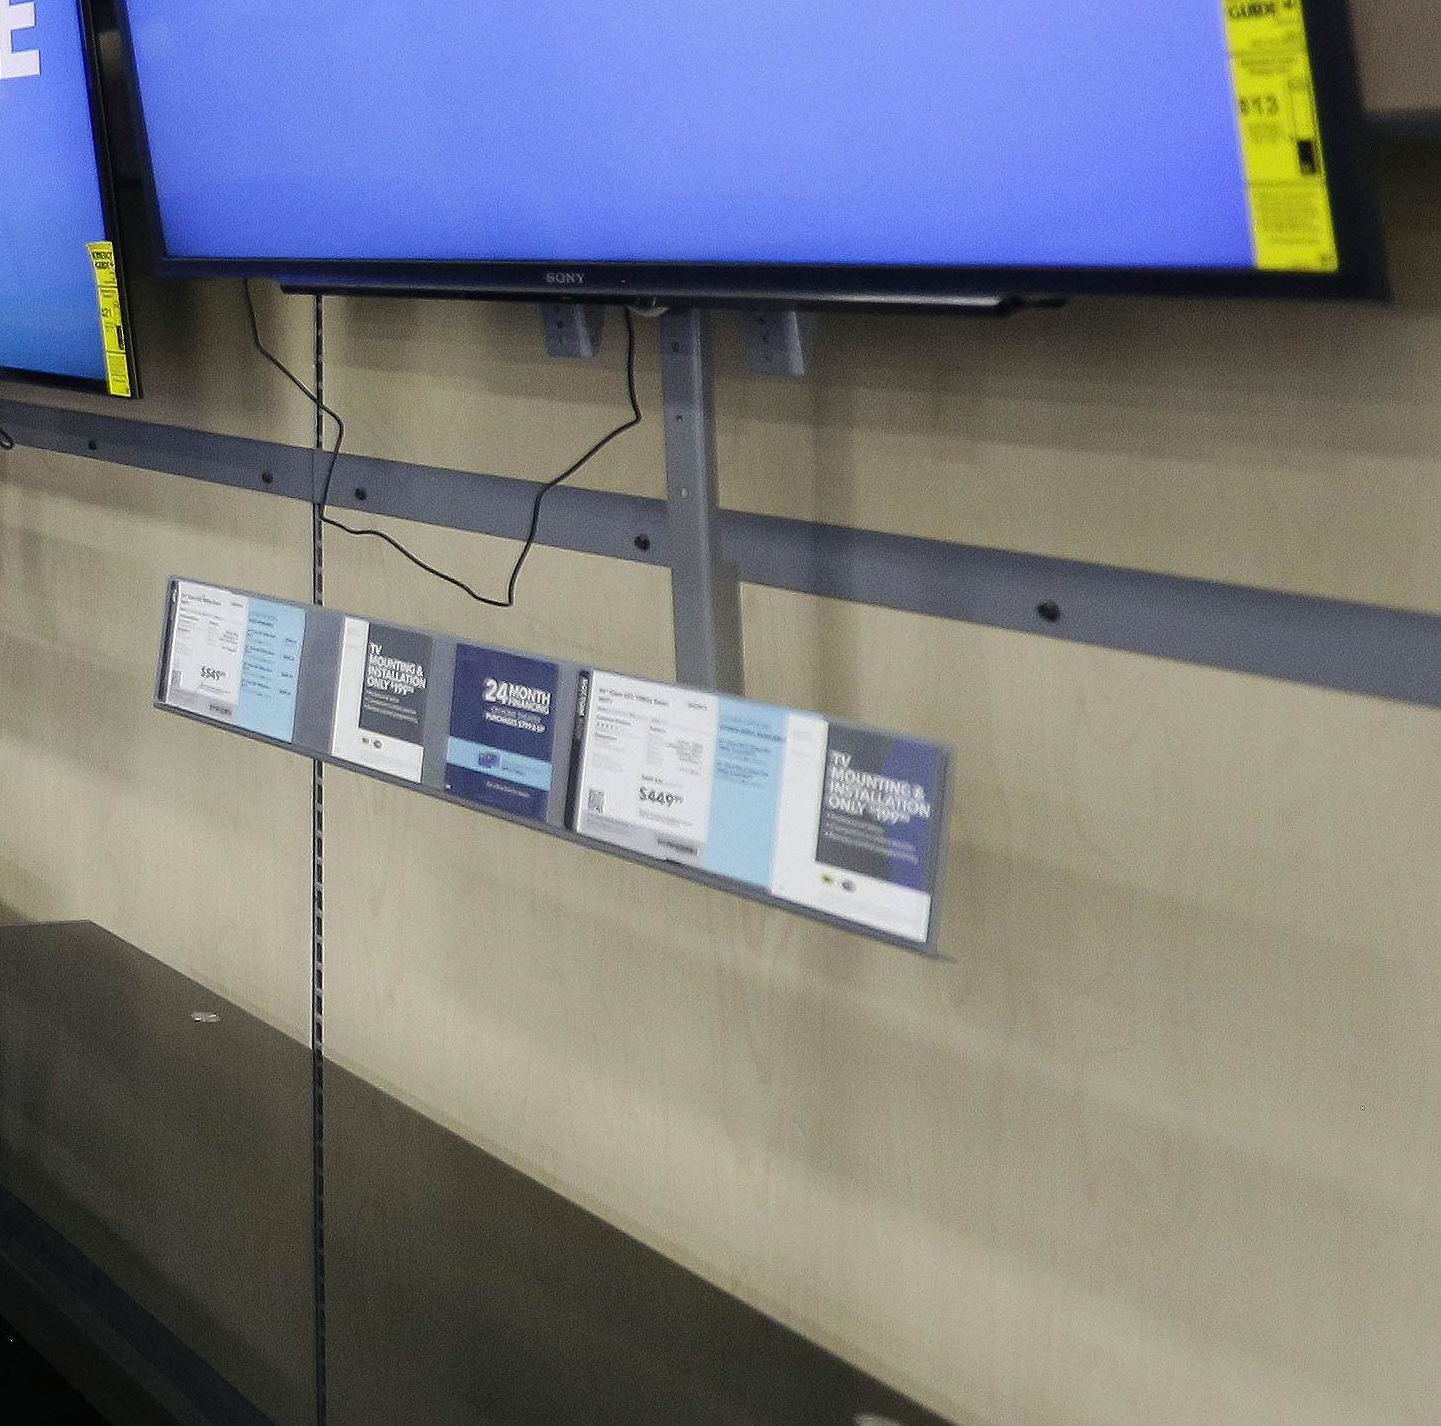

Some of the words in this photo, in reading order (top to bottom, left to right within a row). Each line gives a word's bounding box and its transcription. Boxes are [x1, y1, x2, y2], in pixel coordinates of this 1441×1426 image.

[546, 271, 585, 284] SONY
[370, 643, 383, 656] TV
[369, 654, 417, 675] MOUNTING
[416, 664, 424, 676] &
[367, 677, 390, 691] ONLY
[368, 665, 427, 690] INSTALLATION
[483, 677, 509, 704] 24
[508, 683, 551, 706] MONTH
[832, 751, 852, 768] TV
[830, 766, 913, 798] MOUNTING
[913, 785, 925, 801] &
[828, 781, 932, 819] INSTALLATION
[828, 796, 866, 816] ONLY
